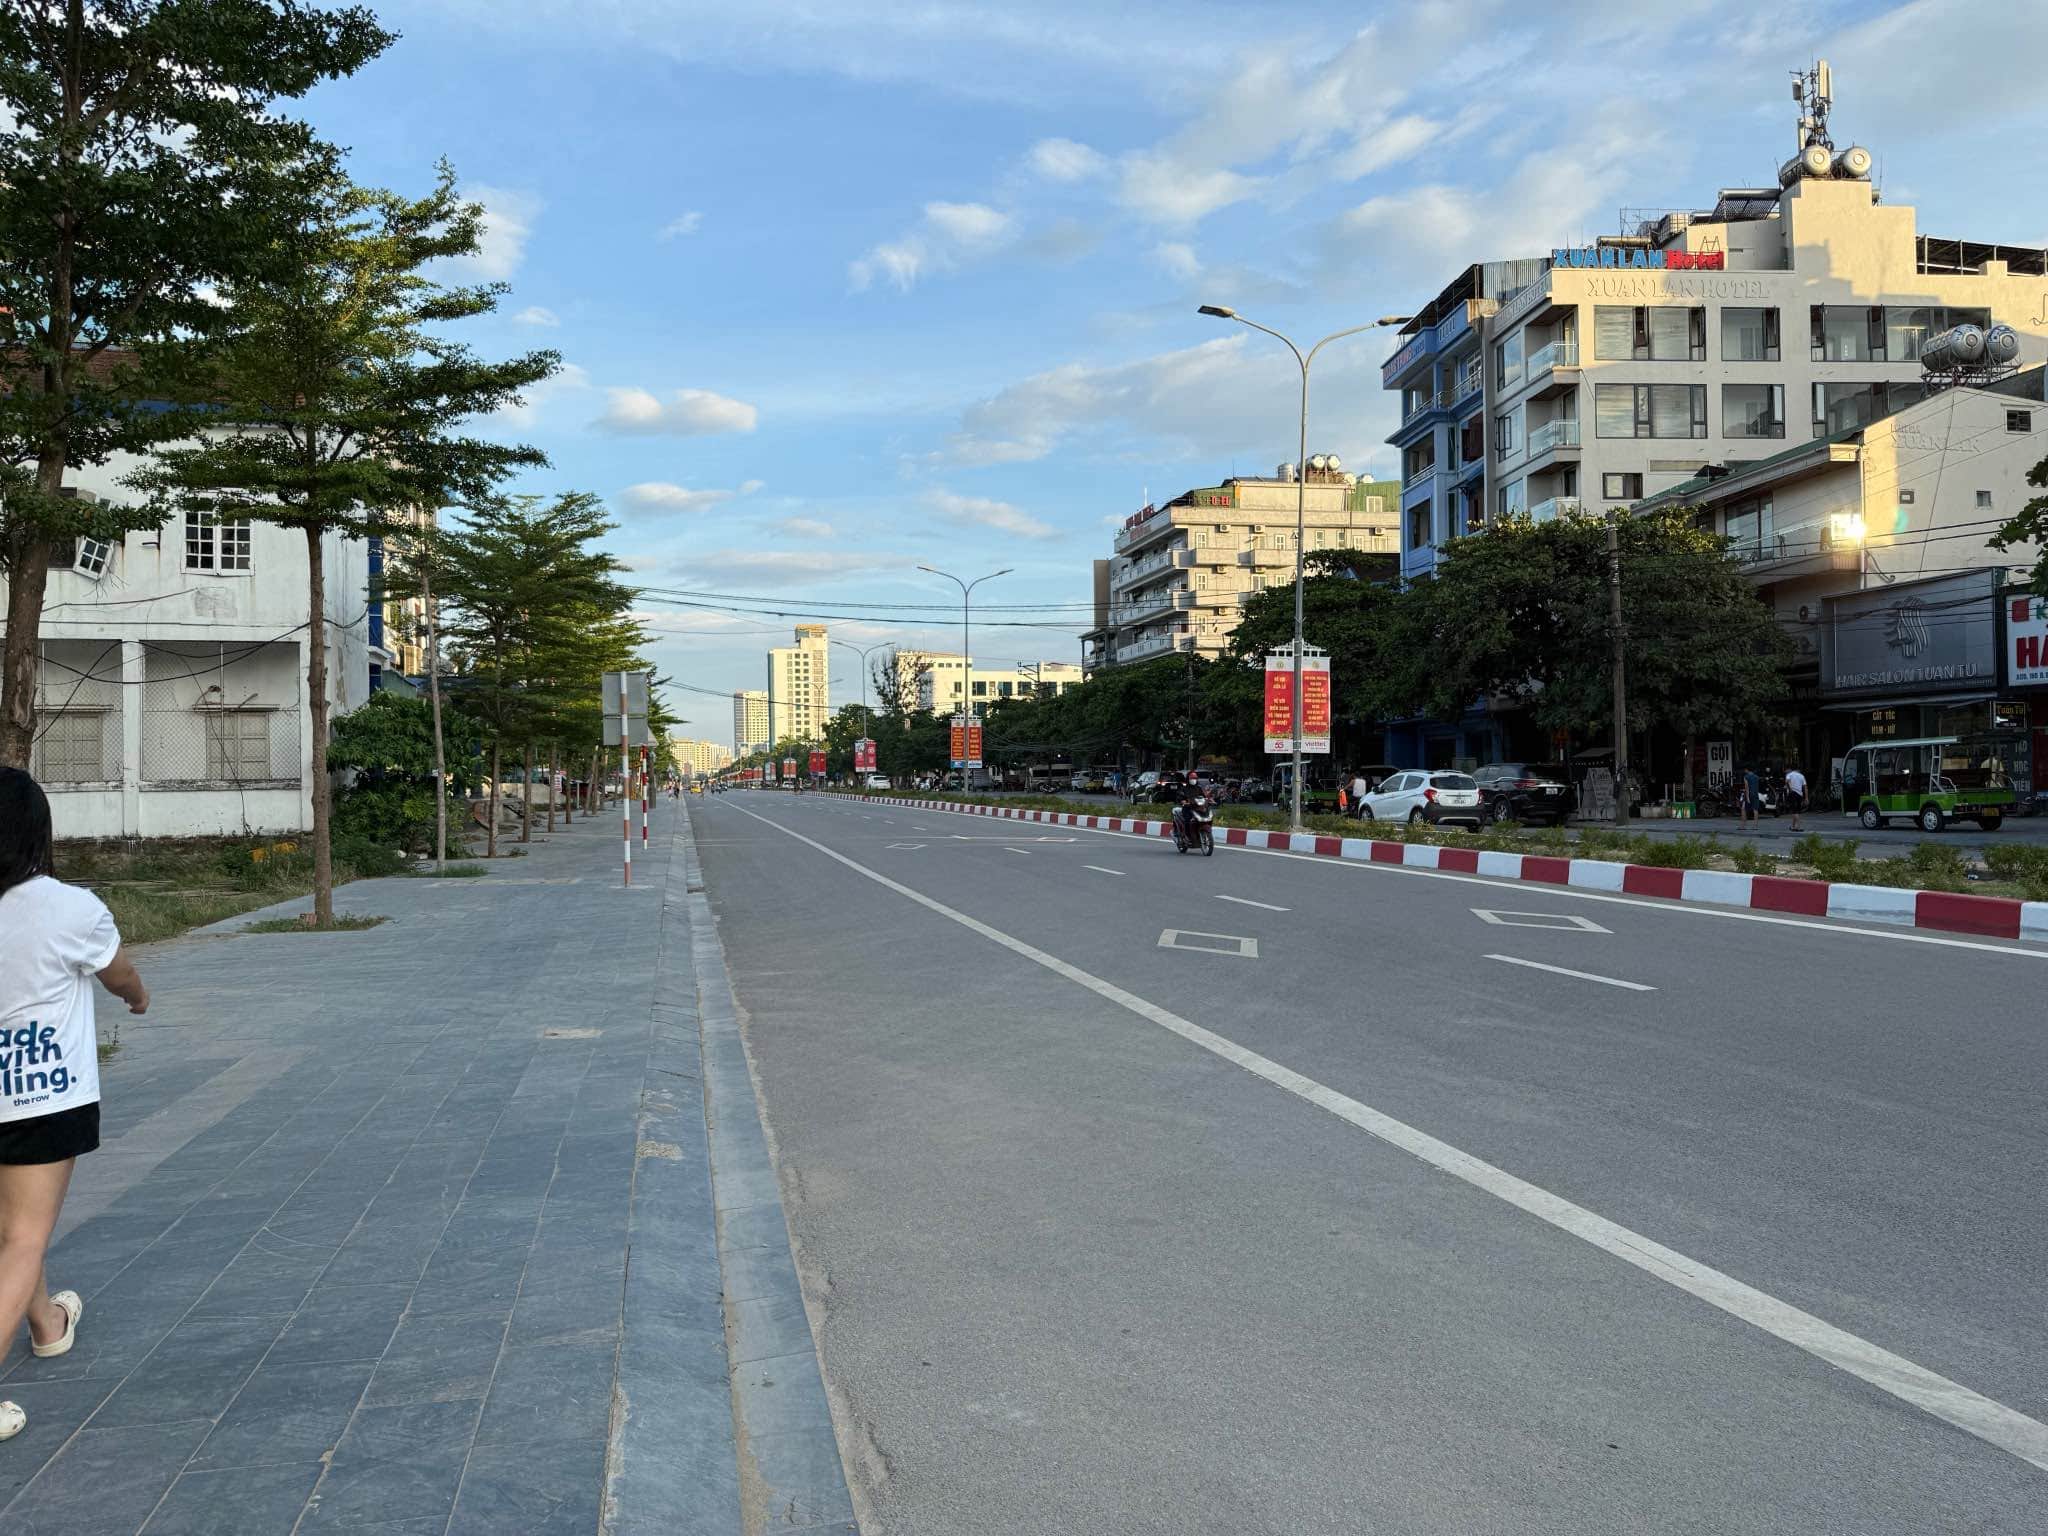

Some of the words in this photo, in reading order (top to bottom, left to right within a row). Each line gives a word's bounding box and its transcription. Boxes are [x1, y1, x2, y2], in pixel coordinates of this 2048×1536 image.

[1619, 249, 1663, 269] LAN
[1667, 250, 1724, 270] Hotel
[1700, 279, 1769, 299] HOTEL
[0, 1066, 77, 1096] ling.
[13, 1098, 30, 1107] the
[32, 1094, 50, 1104] row
